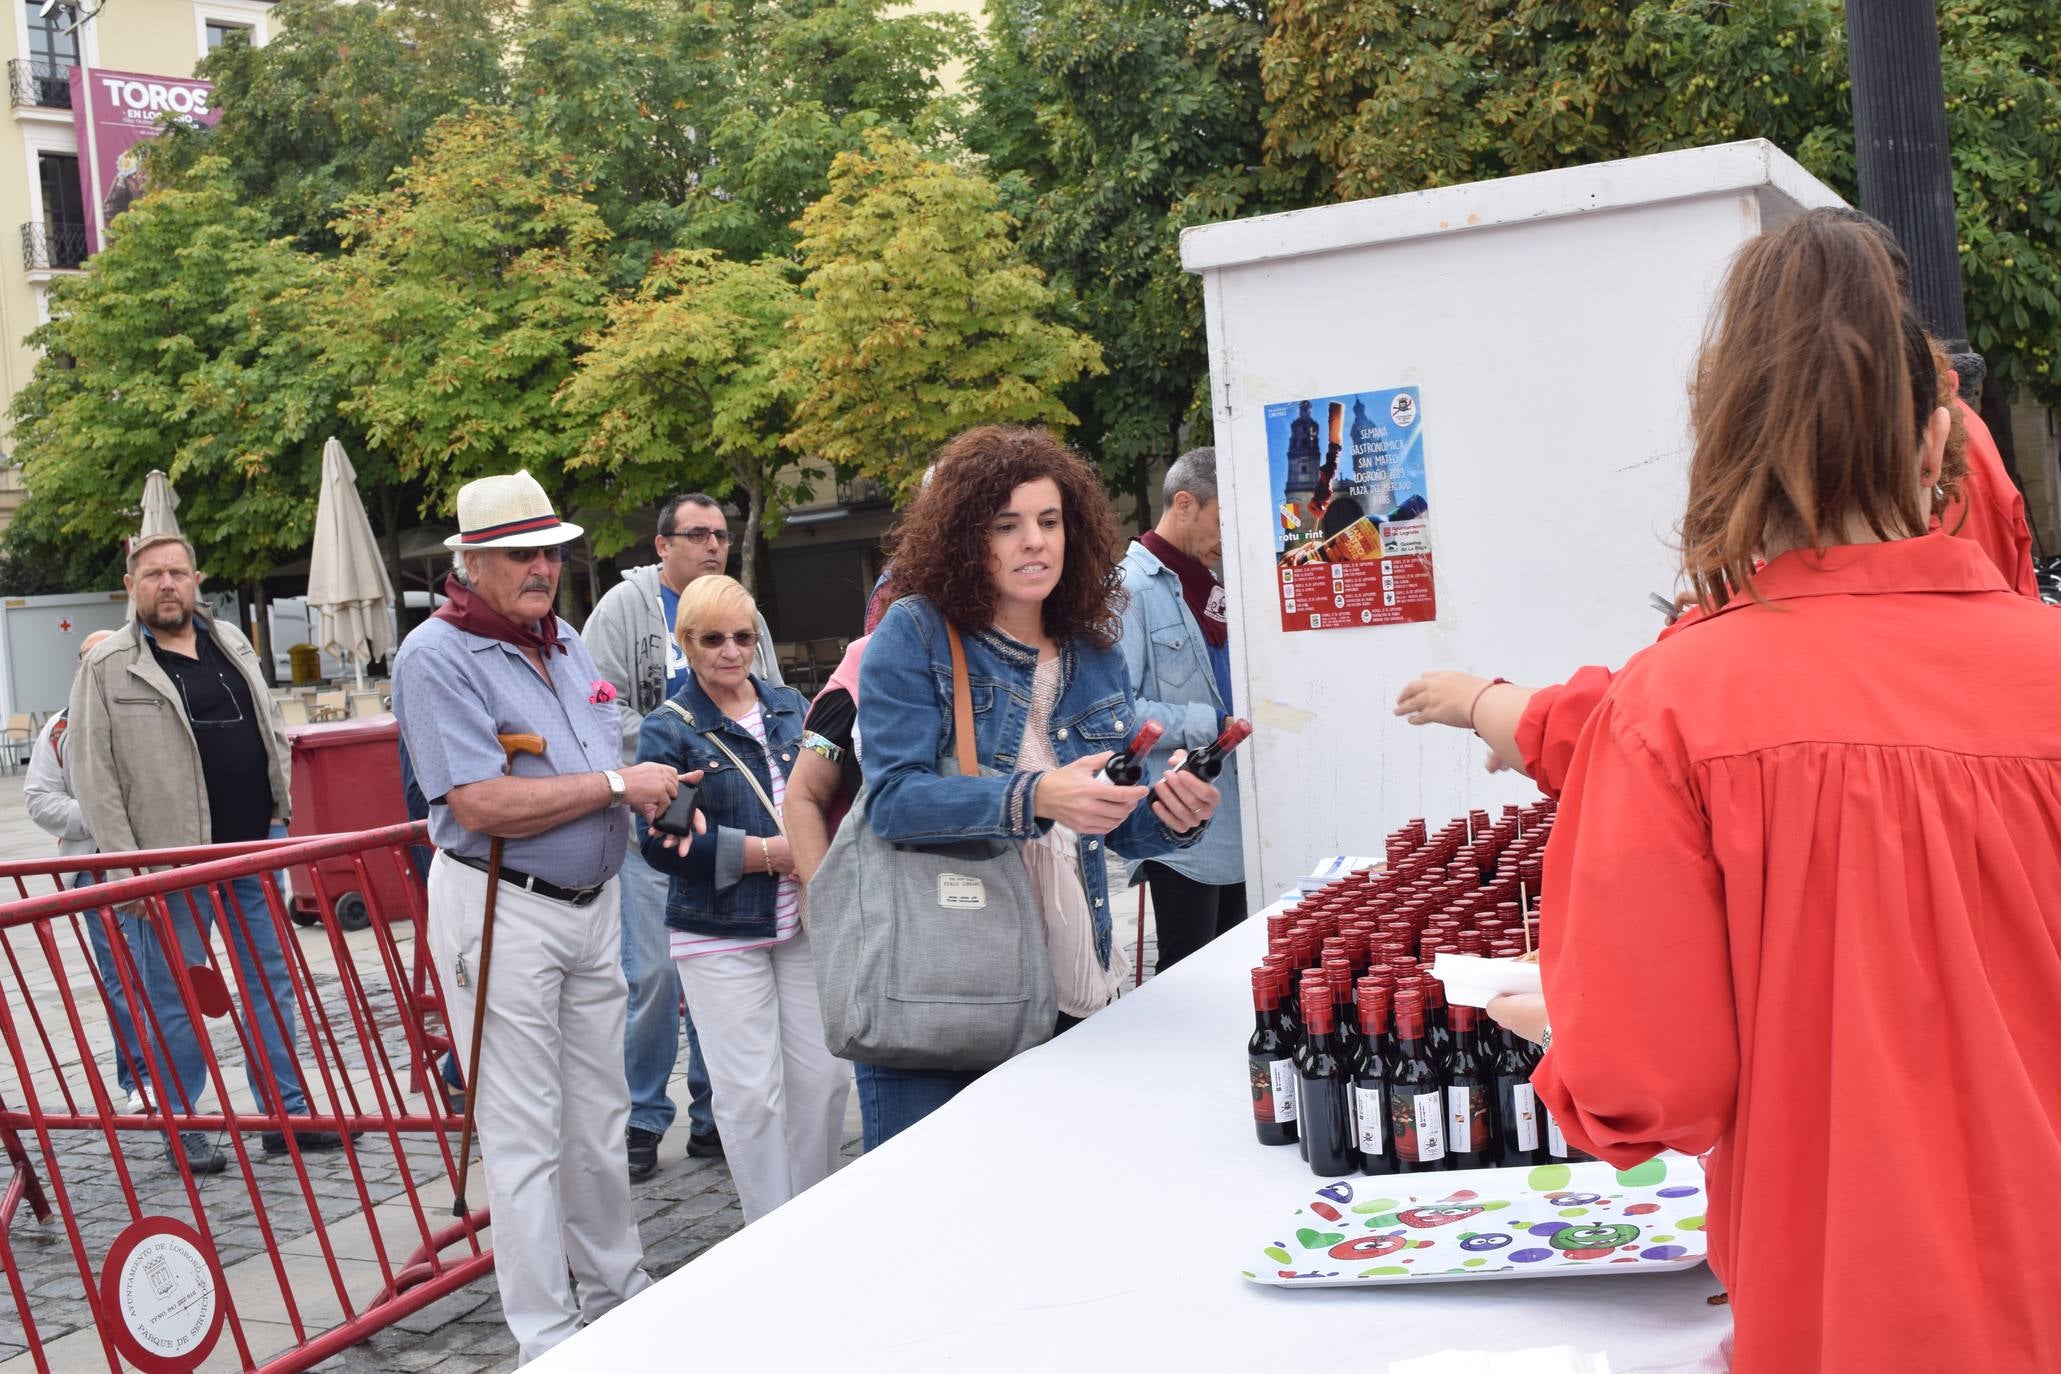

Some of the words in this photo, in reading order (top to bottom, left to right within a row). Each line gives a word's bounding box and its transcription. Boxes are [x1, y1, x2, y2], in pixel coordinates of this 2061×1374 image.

[102, 78, 209, 115] TOROS
[127, 109, 141, 119] EN
[1360, 426, 1388, 440] SEMANA
[1358, 457, 1372, 468] SAN
[1354, 469, 1387, 484] LOGROÑO
[1349, 486, 1368, 497] PLAZA
[126, 1247, 153, 1318] AYUNTAMIENTO
[155, 1243, 166, 1251] DE
[137, 1323, 174, 1348] PARQUE
[176, 1335, 190, 1347] DE
